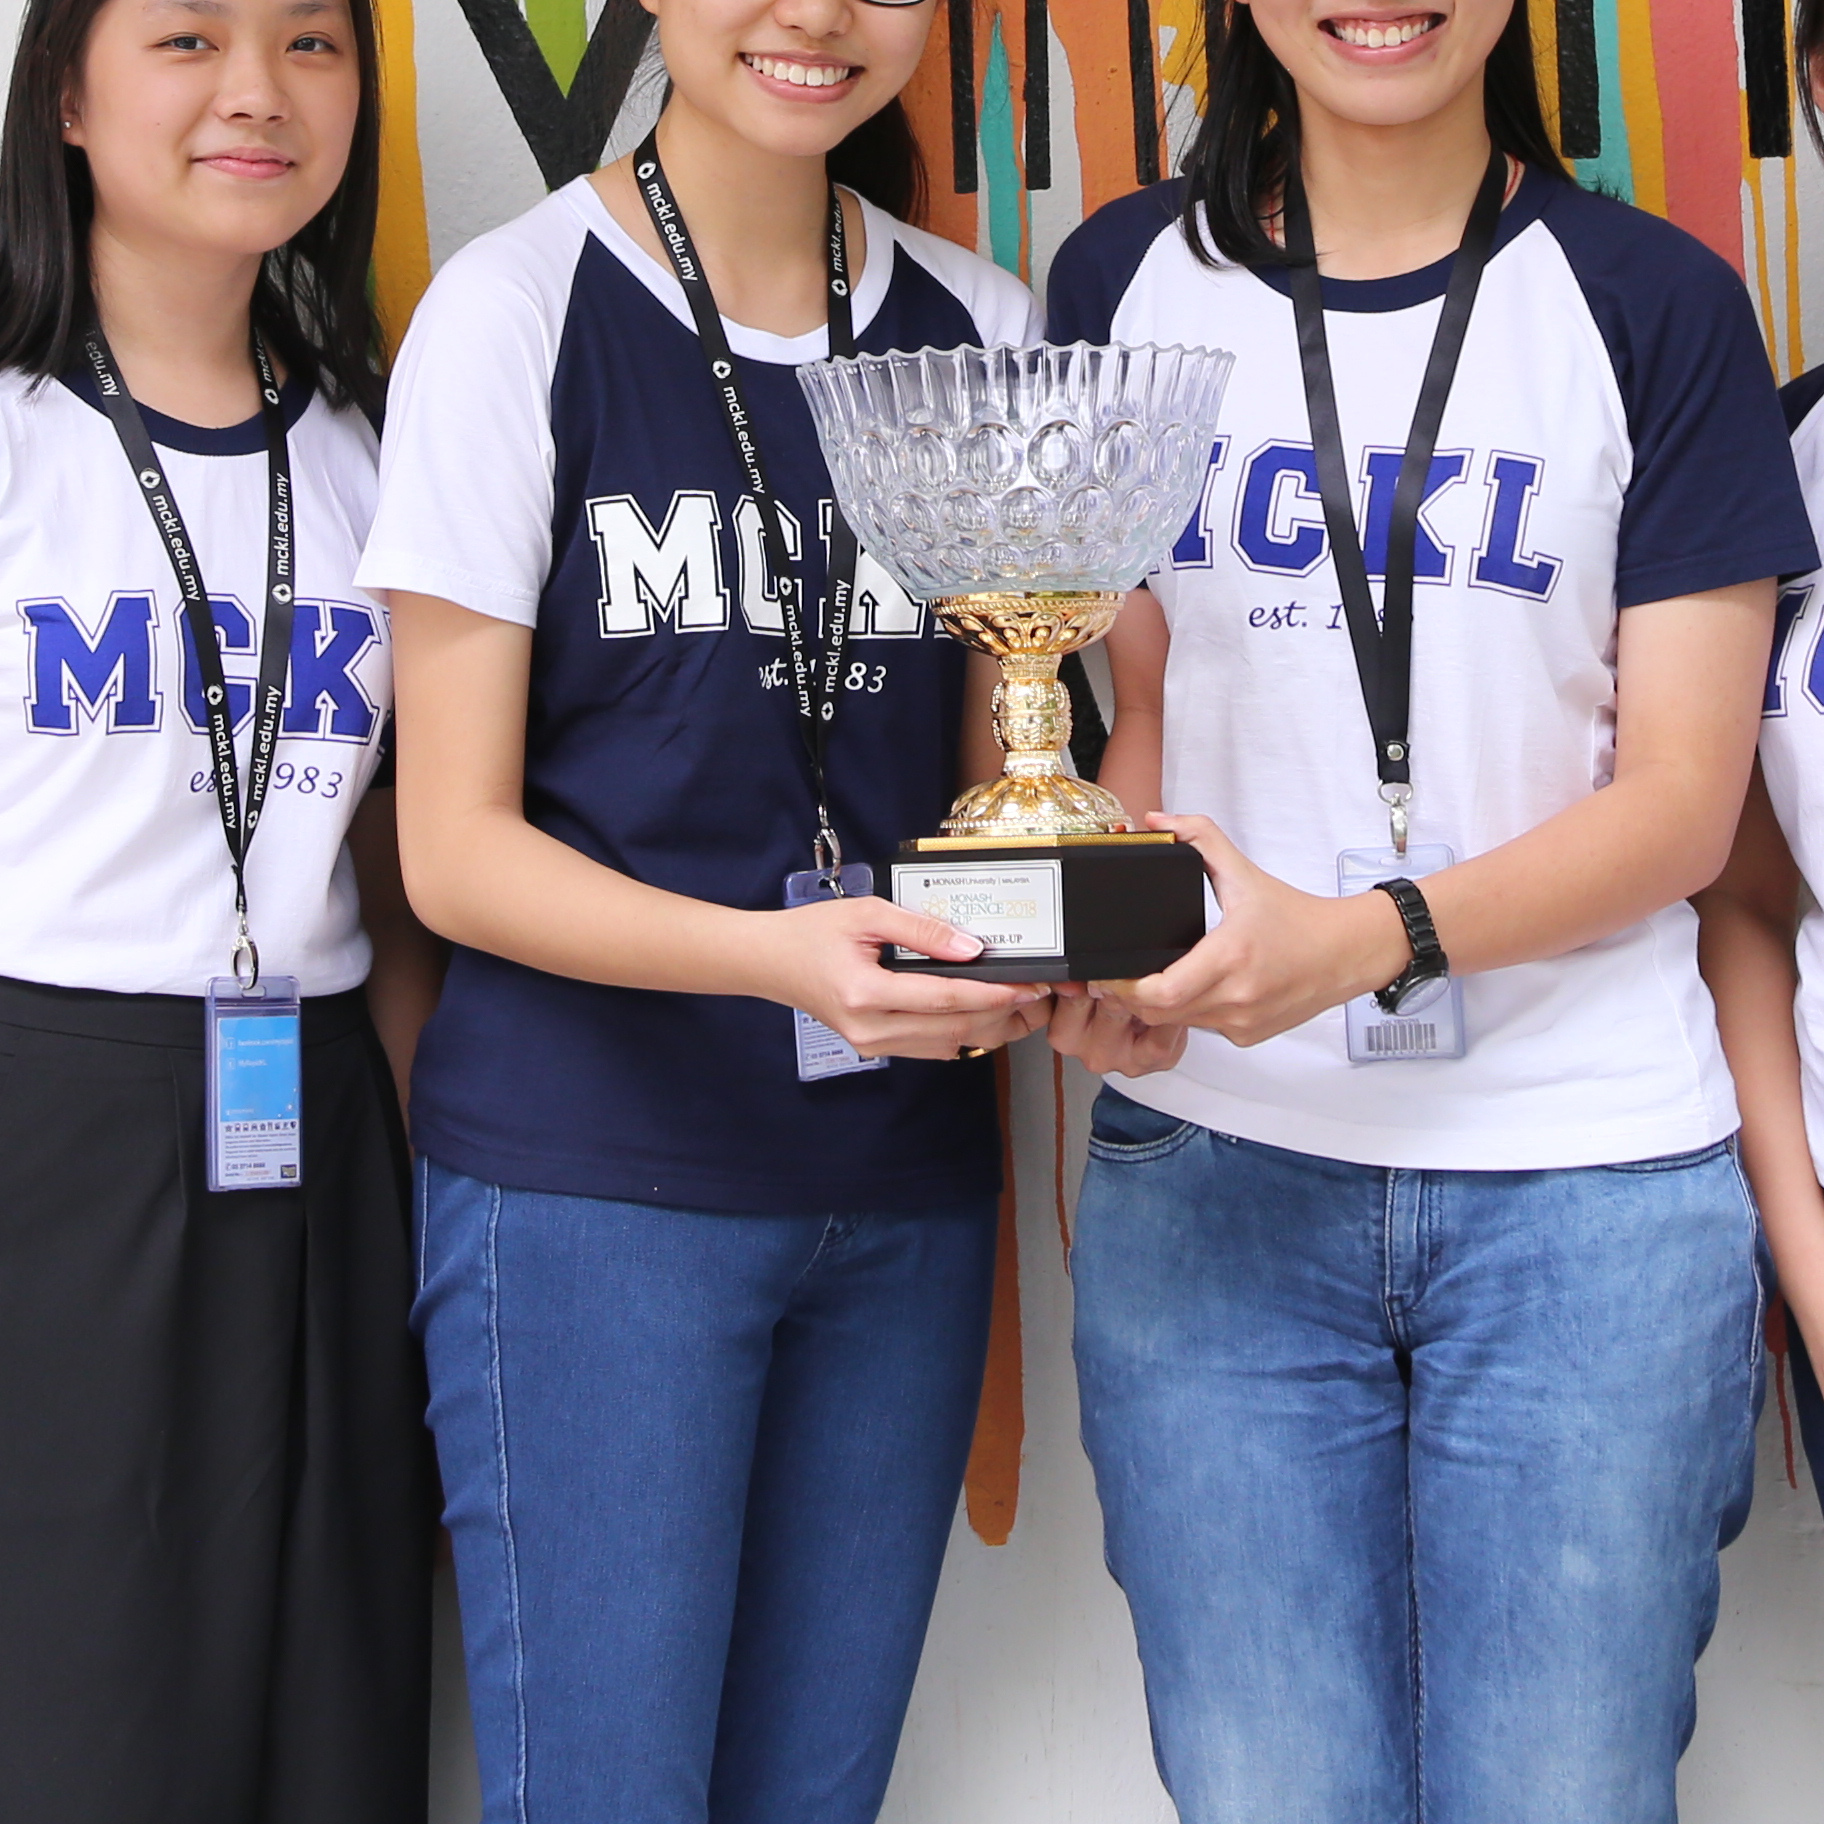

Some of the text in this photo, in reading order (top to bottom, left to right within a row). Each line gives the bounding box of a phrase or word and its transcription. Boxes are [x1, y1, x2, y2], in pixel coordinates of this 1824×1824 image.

[647, 181, 698, 283] mckl.edu.my
[723, 385, 765, 494] mckl.edu.my
[152, 493, 201, 602] mckl.edu.my
[275, 473, 289, 575] mckl.edu.my
[785, 604, 811, 717] mckl.edu.my
[824, 579, 852, 693] mckl.edu.my
[1248, 600, 1307, 630] est.
[17, 589, 391, 746] MCK
[212, 713, 237, 829] mckl.edu.my
[253, 686, 281, 801] mckl.edu.my
[273, 762, 343, 799] 983
[932, 878, 965, 886] MONASH
[950, 893, 992, 903] MONASH
[950, 900, 1037, 916] SCIENCE 2018
[950, 916, 972, 926] CUP
